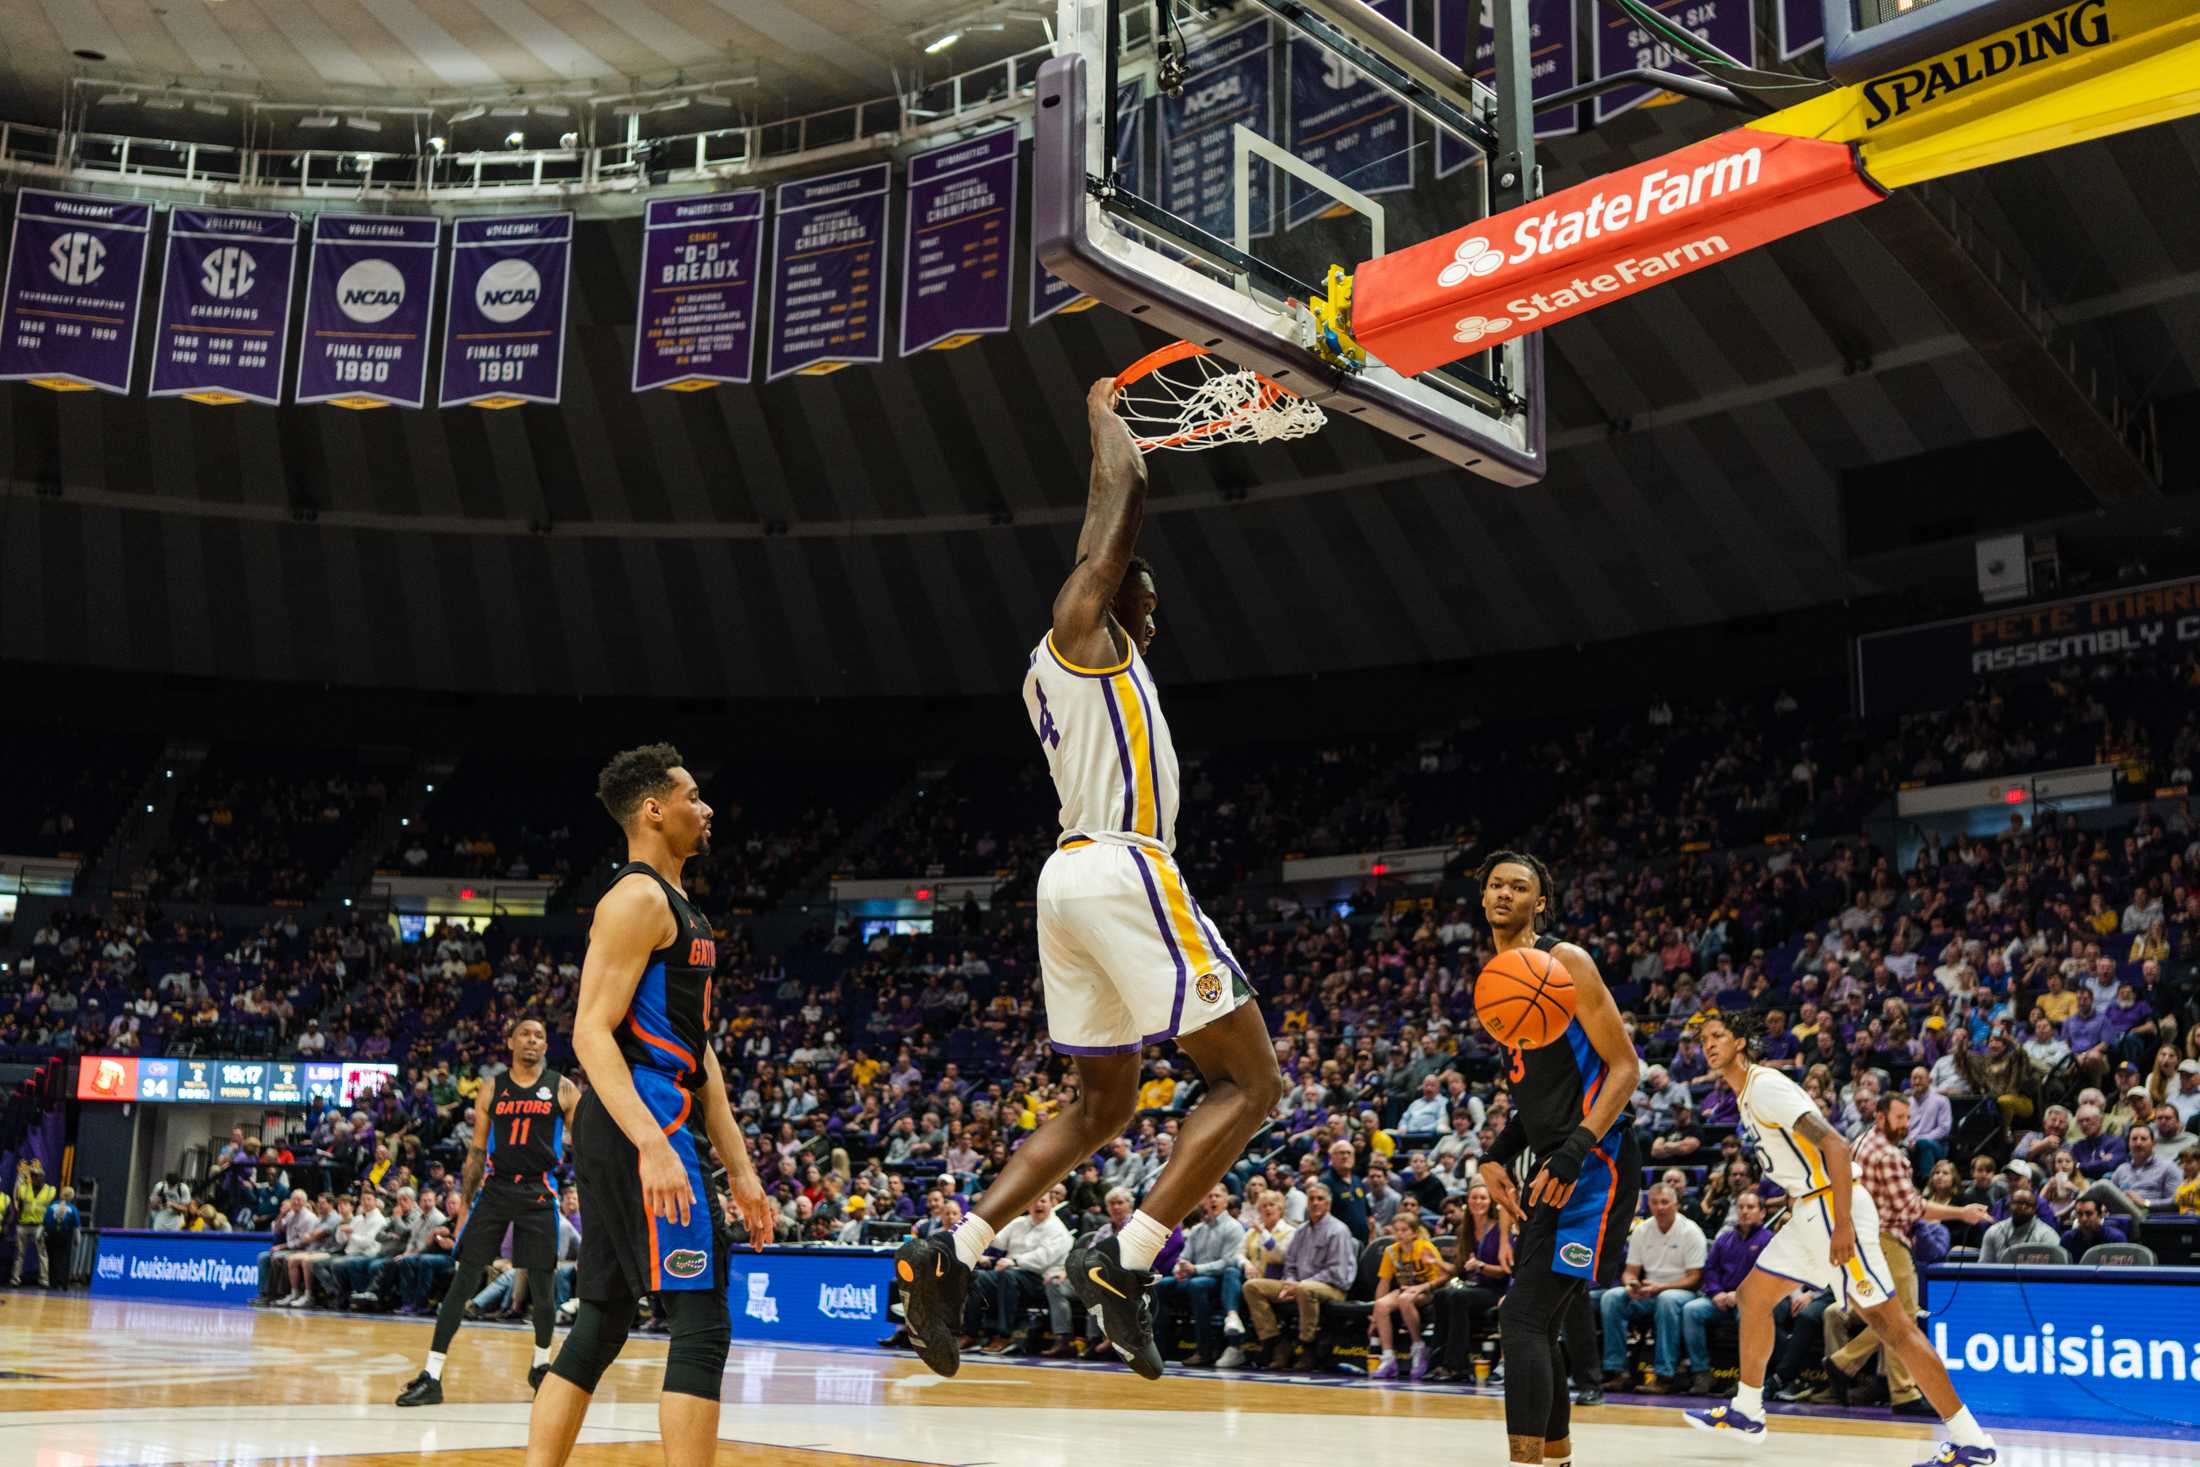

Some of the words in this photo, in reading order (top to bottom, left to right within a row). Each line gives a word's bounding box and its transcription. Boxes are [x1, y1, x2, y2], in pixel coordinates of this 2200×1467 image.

[1863, 0, 2111, 129] SPALDING
[933, 182, 989, 208] NATIONAL
[54, 201, 114, 218] VOLLEYBALL
[927, 193, 996, 223] CHAMPIONS
[205, 218, 264, 233] VOLLEYBALL
[348, 224, 405, 237] VOLLEYBALL
[486, 222, 539, 237] VOLLEYBALL
[802, 216, 860, 236] NATIONAL
[795, 225, 866, 251] CHAMPIONS
[48, 232, 108, 286] SEC
[201, 246, 257, 300] SEC
[662, 259, 739, 284] BREAUX
[343, 289, 400, 305] NCAA
[483, 289, 536, 306] NCAA
[191, 305, 258, 320] CHAMPIONS
[325, 344, 363, 359] FINAL
[367, 345, 403, 360] FOUR
[466, 345, 502, 360] FINAL
[505, 344, 539, 358] FOUR
[335, 360, 389, 382] 1990
[478, 360, 525, 382] 1991
[1971, 607, 2075, 646] PETE
[1972, 620, 2164, 674] ASSEMBLY
[143, 1078, 168, 1098] 34
[495, 1100, 552, 1115] GATORS
[509, 1118, 531, 1146] 11
[1934, 1322, 2200, 1382] Louisian
